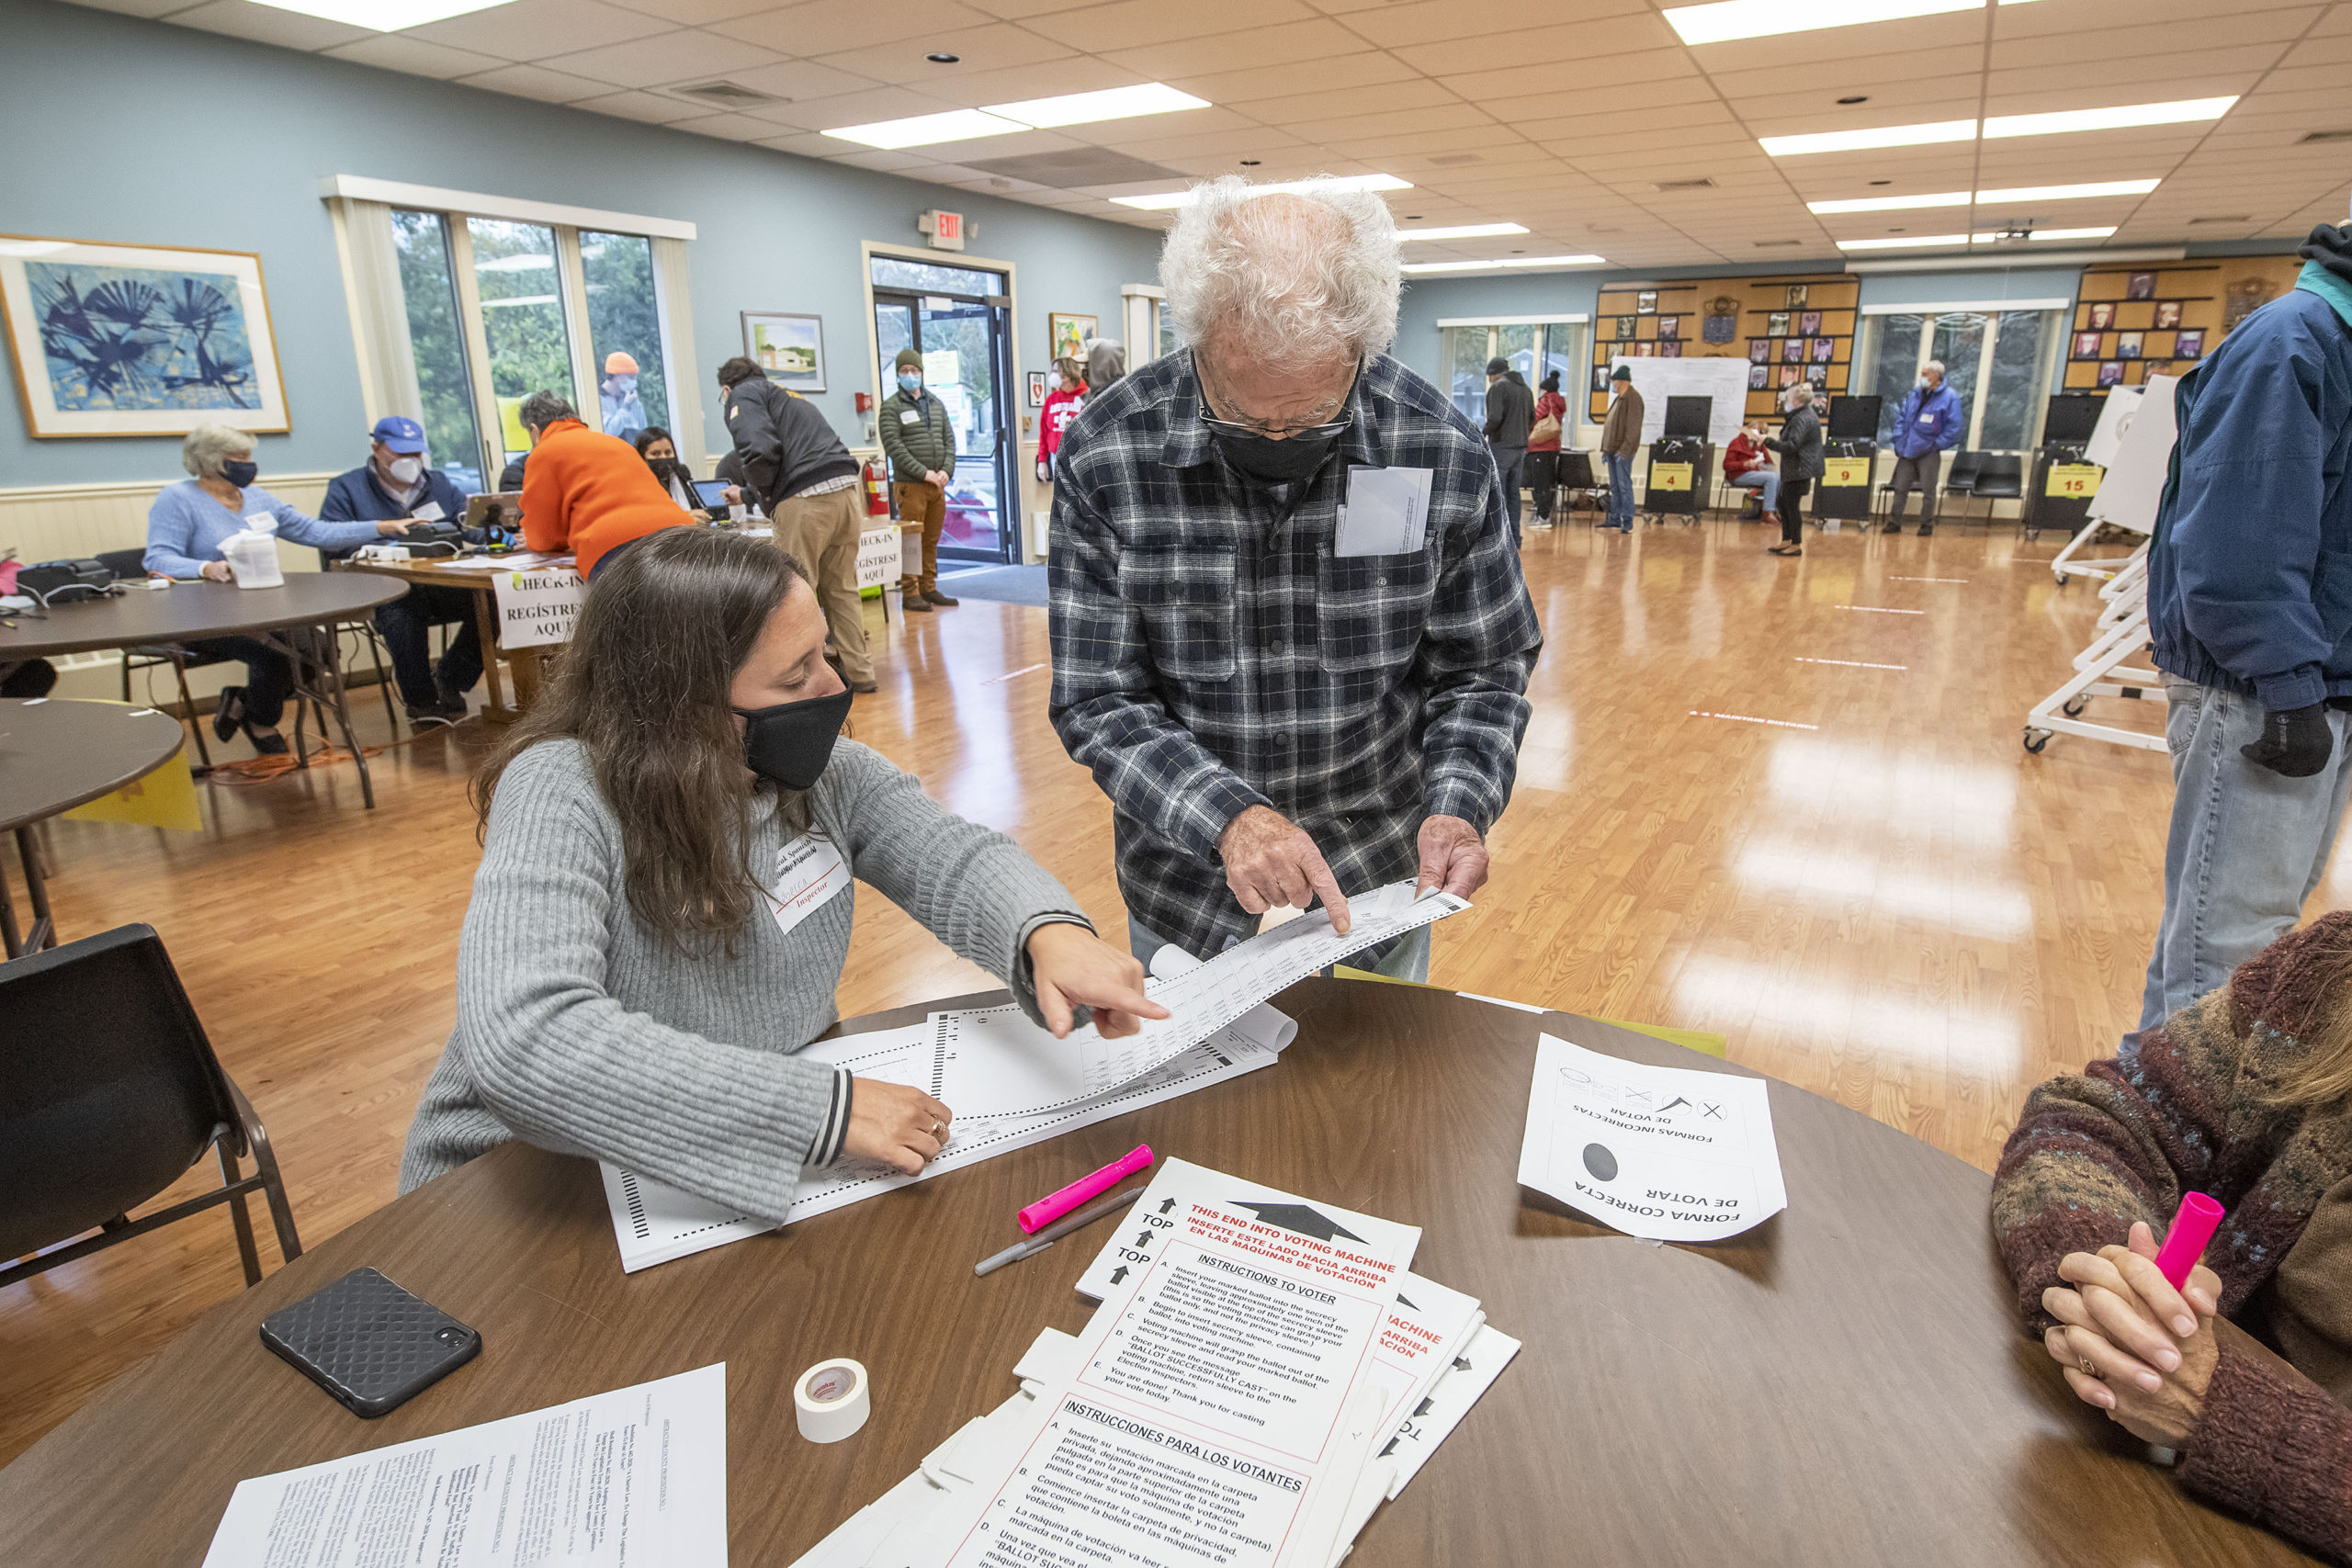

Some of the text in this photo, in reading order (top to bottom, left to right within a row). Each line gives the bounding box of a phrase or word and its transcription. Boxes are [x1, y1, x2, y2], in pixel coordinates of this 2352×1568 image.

[939, 214, 958, 239] EXIT
[1667, 475, 1675, 486] 4
[1841, 470, 1850, 481] 9
[2064, 479, 2085, 491] 15
[787, 839, 812, 859] Spanish
[797, 882, 829, 907] Inspector
[1573, 1105, 1713, 1144] FORMAS INCORRECTAS
[1610, 1107, 1671, 1124] DE VOTAR
[1143, 1213, 1174, 1229] TOP
[1575, 1180, 1740, 1223] FORMA CORRECTA
[1645, 1189, 1738, 1208] DE VOTAR
[1118, 1247, 1150, 1264] TOP
[1186, 1216, 1386, 1283] INSERTE ESTE LADO HACIA ARRIBA
[1189, 1225, 1376, 1290] EN LAS MÁQUINAS DE VOTACIÓN
[1192, 1203, 1396, 1273] THIS END INTO VOTING MACHINE
[1170, 1273, 1197, 1286] sleeve,
[1199, 1281, 1228, 1296] leaving
[1228, 1292, 1286, 1314] approximately
[1287, 1311, 1303, 1319] one
[1304, 1315, 1323, 1325] inch
[1335, 1325, 1349, 1334] the
[1175, 1266, 1198, 1278] Insert
[1197, 1274, 1217, 1283] your
[1217, 1280, 1249, 1294] marked
[1249, 1290, 1272, 1302] ballot
[1272, 1297, 1289, 1307] into
[1290, 1303, 1304, 1312] the
[1305, 1309, 1338, 1323] secrecy
[1196, 1254, 1337, 1305] INSTRUCTIONS TO VOTER
[1148, 1307, 1256, 1348] ballot, into voting machine.
[1152, 1301, 1176, 1314] Begin
[1187, 1312, 1211, 1325] insert
[1211, 1322, 1244, 1337] secrecy
[1245, 1333, 1273, 1347] sleeve,
[1275, 1343, 1321, 1362] containing
[1159, 1291, 1315, 1348] ballot only, and not the privacy sleeve.)
[1162, 1284, 1181, 1295] (this
[1202, 1298, 1216, 1306] the
[1217, 1303, 1243, 1316] voting
[1243, 1312, 1279, 1327] machine
[1280, 1324, 1295, 1333] can
[1296, 1329, 1321, 1341] grasp
[1322, 1337, 1343, 1347] your
[1167, 1278, 1190, 1290] ballot
[1191, 1287, 1216, 1299] visible
[1227, 1298, 1240, 1307] the
[1241, 1303, 1255, 1313] top
[1266, 1311, 1280, 1320] the
[1281, 1316, 1314, 1331] secrecy
[1316, 1327, 1343, 1339] sleeve
[1383, 1330, 1419, 1354] ARRIBA
[1061, 1437, 1240, 1506] privada, dejando aproximadamente una
[1062, 1400, 1302, 1494] INSTRUCCIONES PARA LOS VOTANTES
[1068, 1427, 1099, 1444] Inserte
[1100, 1440, 1112, 1449] su
[1116, 1446, 1154, 1464] votación
[1155, 1461, 1195, 1480] marcada
[1197, 1476, 1209, 1484] en
[1211, 1479, 1220, 1488] la
[1222, 1484, 1258, 1502] carpeta
[1044, 1462, 1272, 1552] pueda captar su voto solamente, y no la carpeta).
[1050, 1452, 1238, 1528] (esto es para que la máquina de votación
[1056, 1445, 1245, 1519] pulgada en la parte superior de la carpeta
